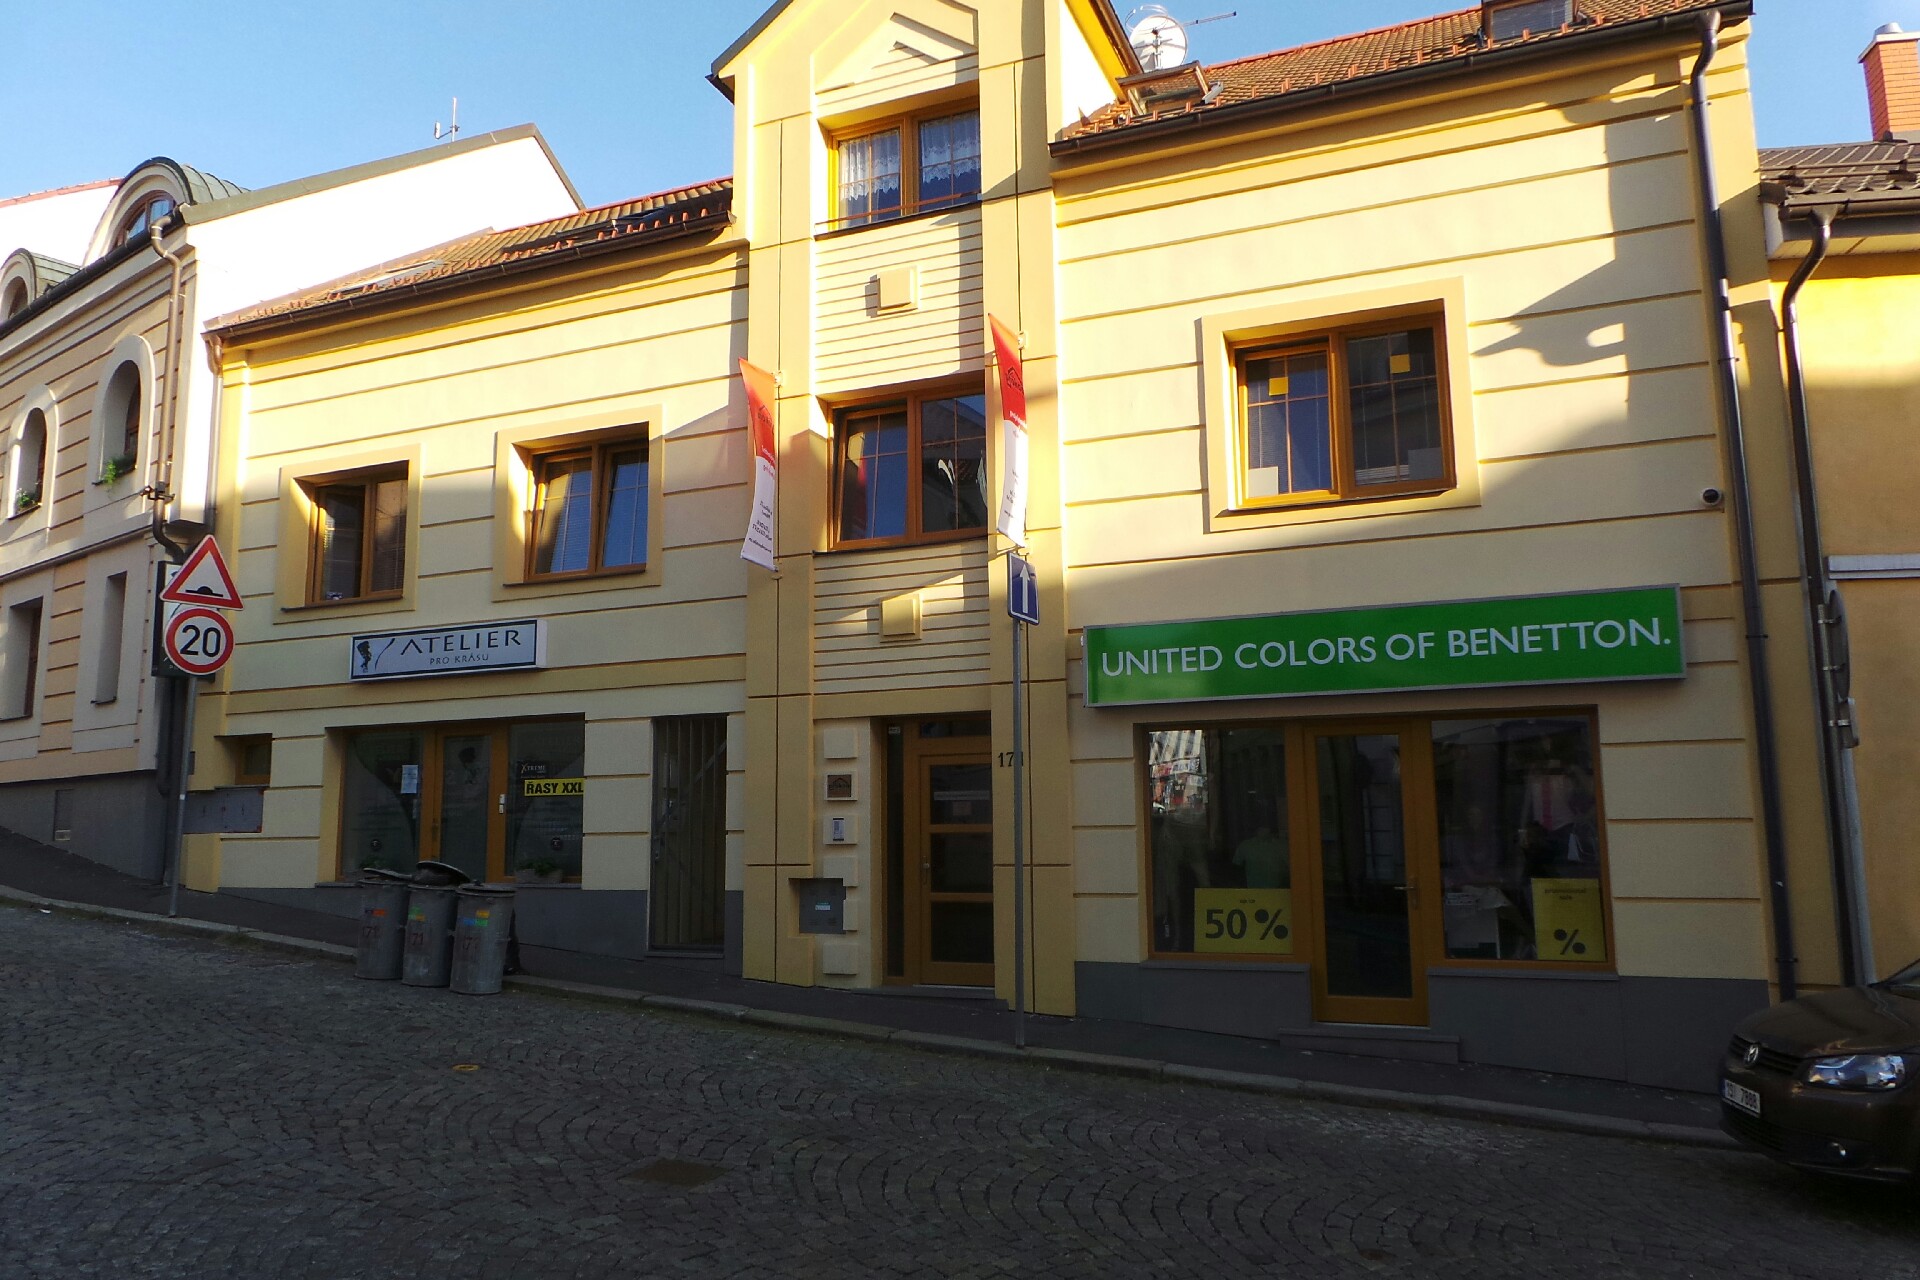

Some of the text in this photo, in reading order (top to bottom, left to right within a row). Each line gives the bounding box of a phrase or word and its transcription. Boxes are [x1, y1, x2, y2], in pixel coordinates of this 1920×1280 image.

[180, 624, 221, 658] 20
[400, 629, 521, 657] ATELIER
[1102, 617, 1671, 677] UNITED COLORS OF BENETTON.
[429, 652, 489, 666] PRO KRÁSU
[526, 781, 584, 794] ŘASY XXL
[1553, 928, 1587, 955] %
